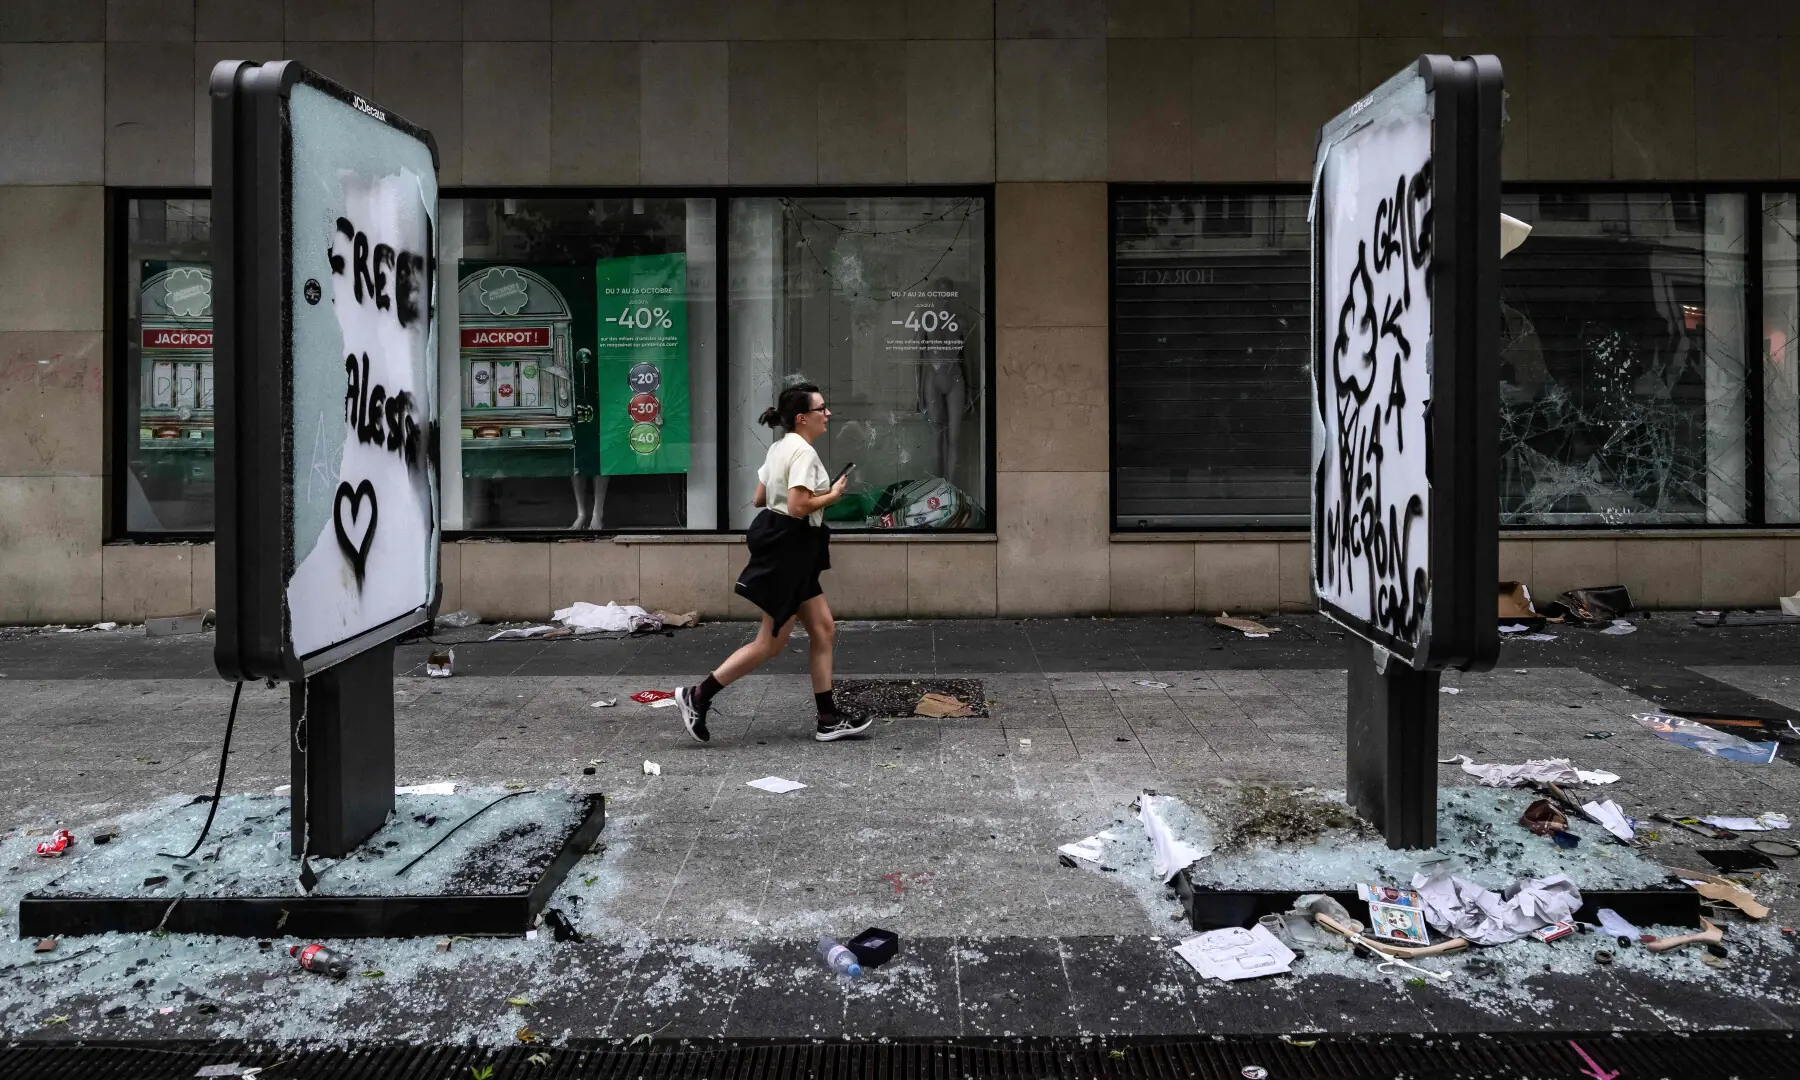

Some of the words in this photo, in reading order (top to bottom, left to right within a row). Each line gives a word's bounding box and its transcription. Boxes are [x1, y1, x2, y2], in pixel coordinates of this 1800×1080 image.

[352, 95, 386, 122] JCDecaux
[605, 307, 672, 328] -40%
[891, 310, 959, 332] -40%
[155, 333, 213, 344] JACKPOT
[472, 332, 532, 343] JACKPOT
